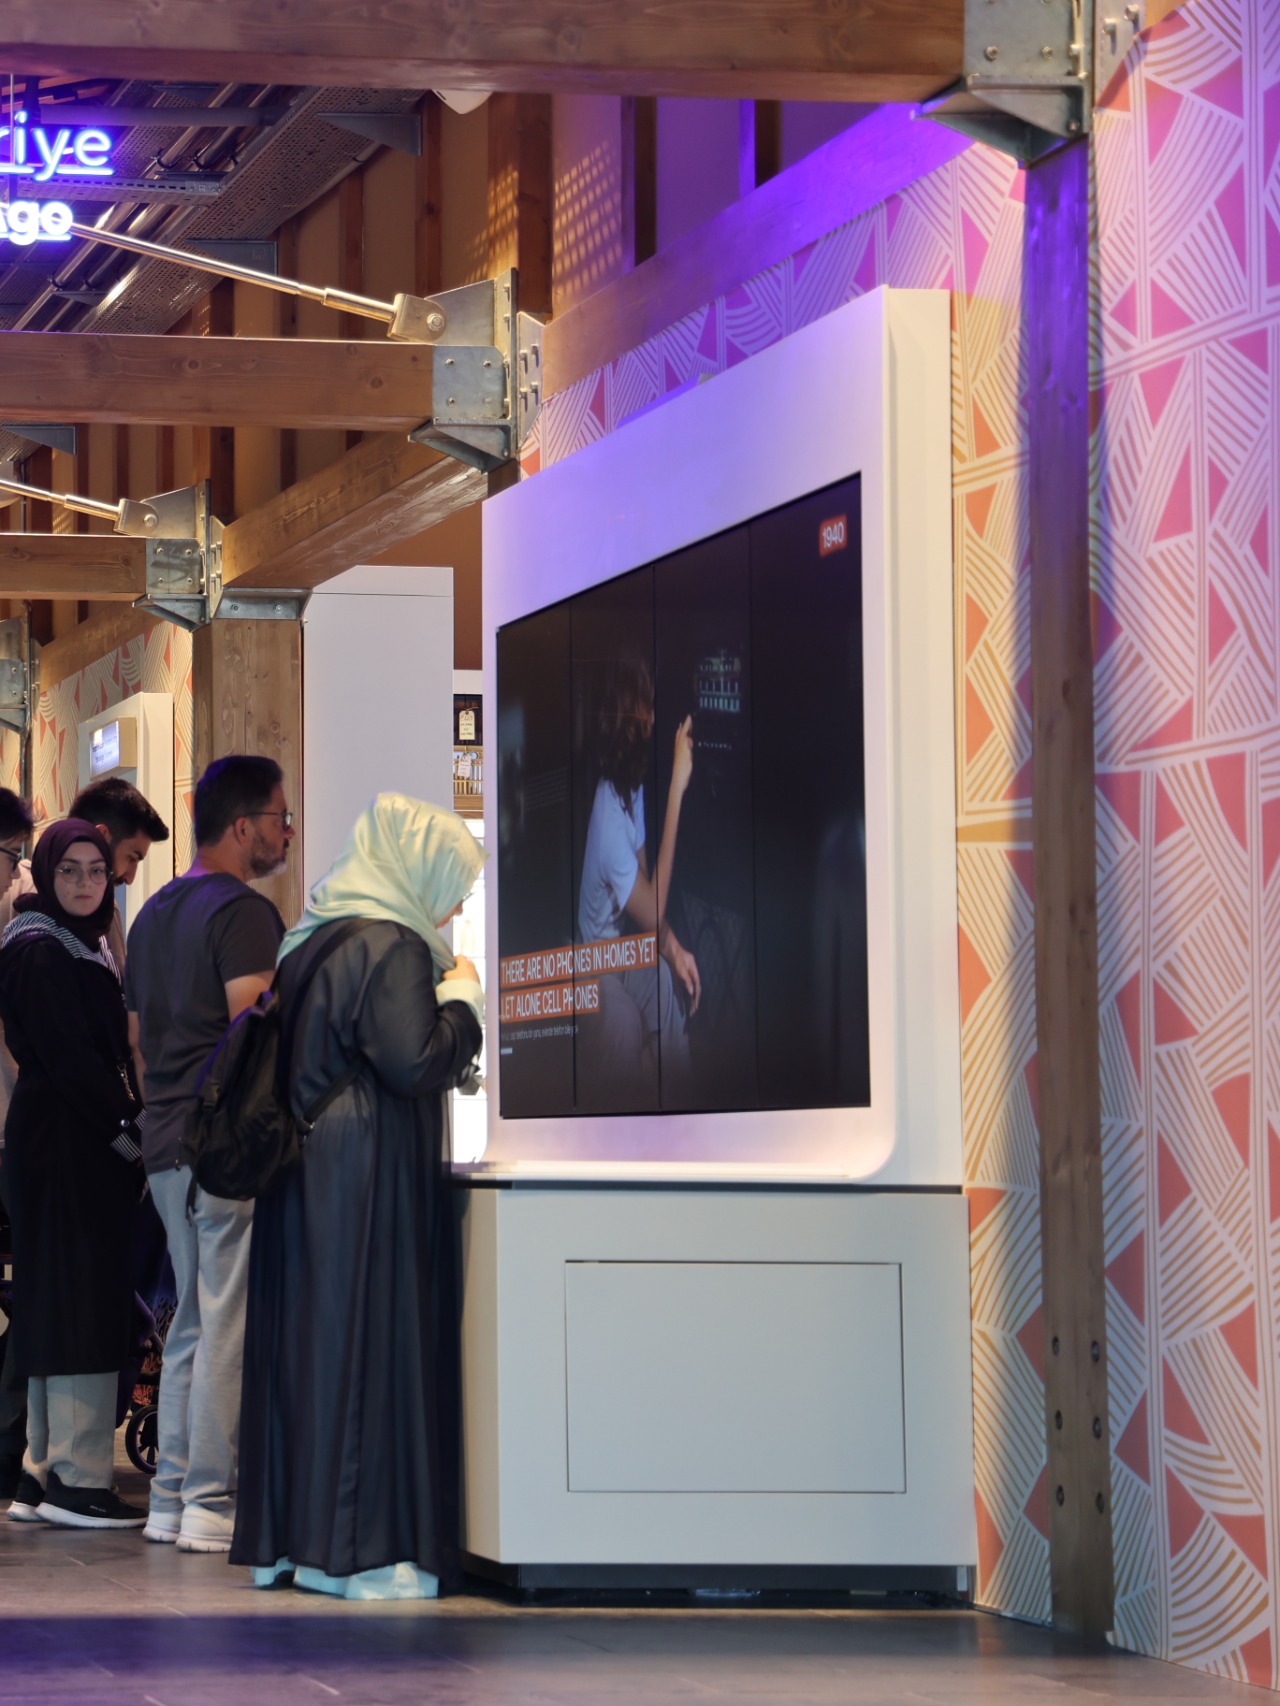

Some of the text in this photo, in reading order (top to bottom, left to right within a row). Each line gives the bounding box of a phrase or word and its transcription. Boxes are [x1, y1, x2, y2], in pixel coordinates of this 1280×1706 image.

[822, 521, 845, 549] 1940
[501, 936, 656, 985] THERE ARE NO PHONES IN HOMES YET
[501, 984, 598, 1020] LET ALONE CELL PHONES
